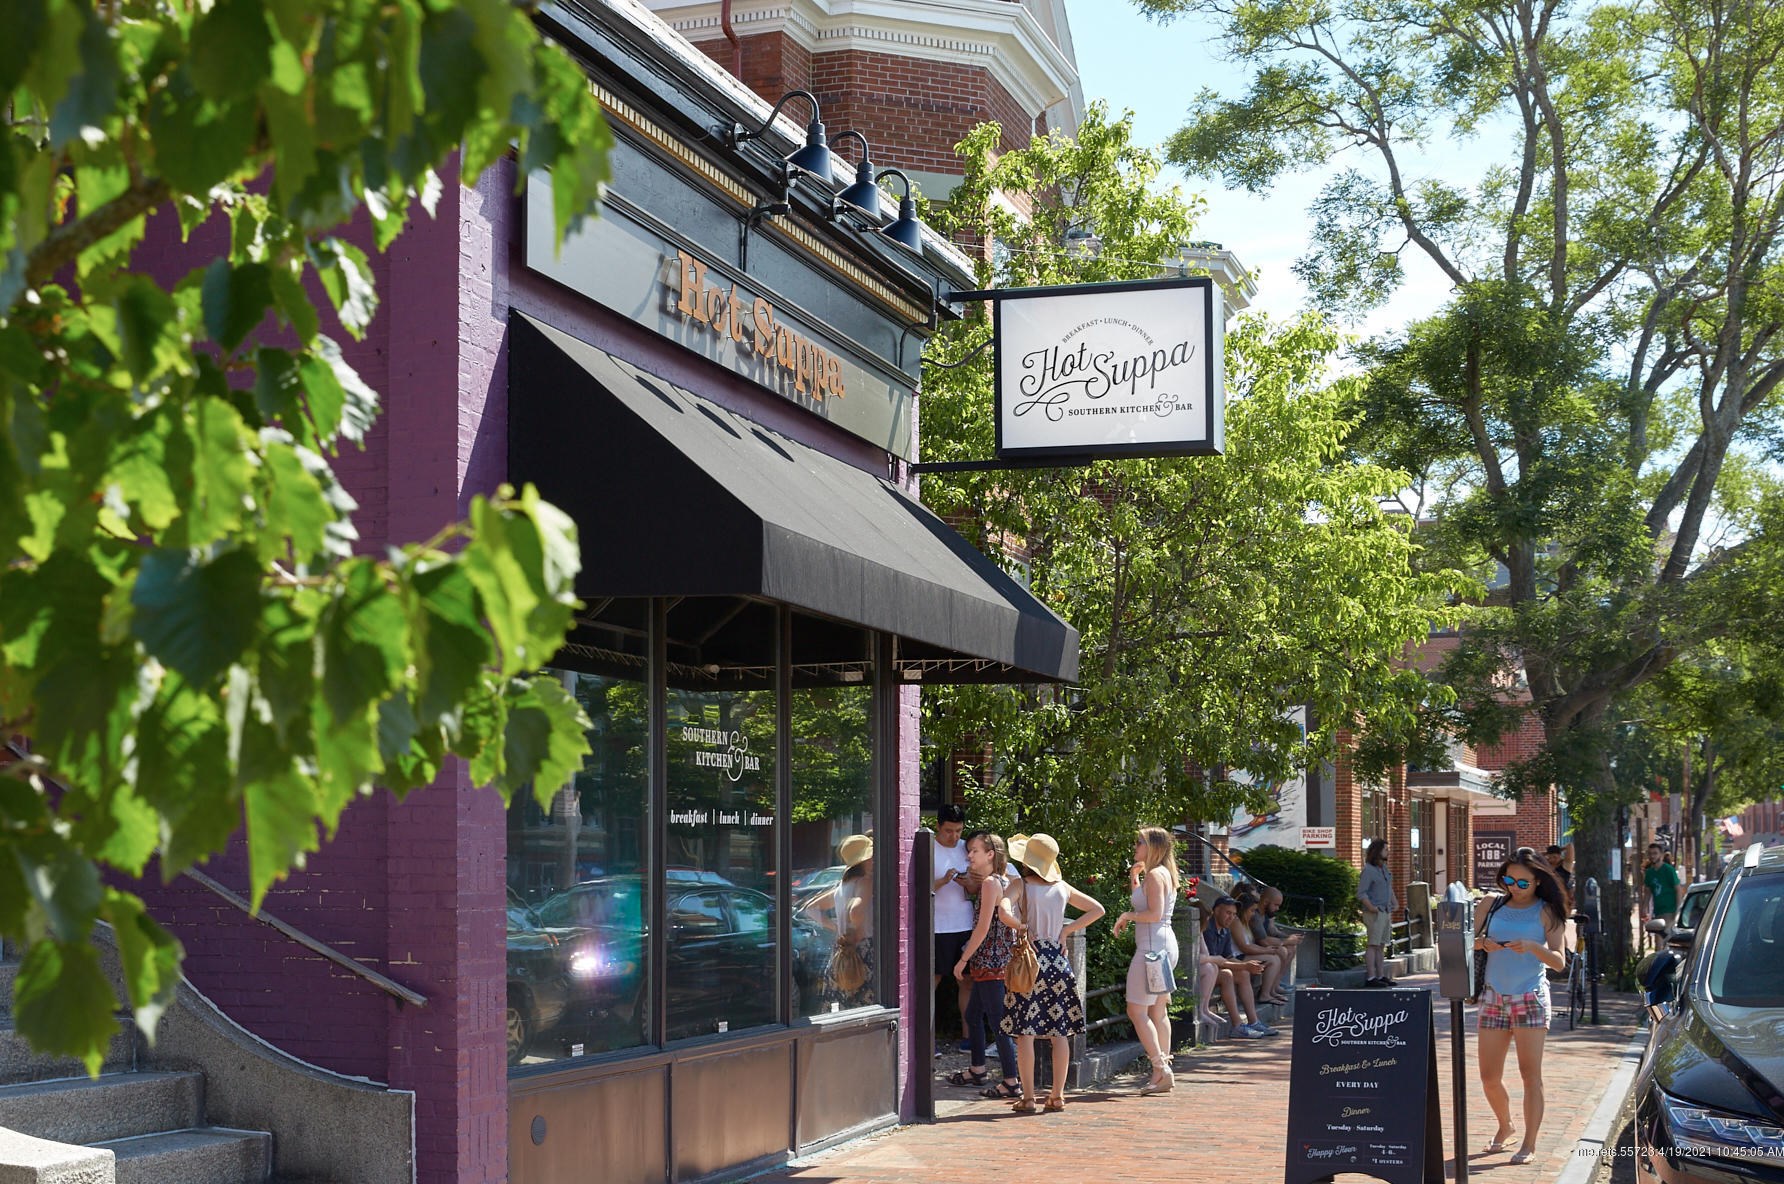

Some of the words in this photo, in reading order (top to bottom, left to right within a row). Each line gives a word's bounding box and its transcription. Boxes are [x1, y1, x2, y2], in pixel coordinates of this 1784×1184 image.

[677, 249, 743, 343] Hot
[753, 296, 846, 401] Suppa
[1062, 318, 1099, 343] BREAKFAST
[1104, 317, 1128, 327] LUNCH
[1132, 324, 1154, 346] DINNER
[1019, 342, 1093, 397] Hot
[1085, 341, 1195, 400] Suppa
[1068, 406, 1117, 417] SOUTHERN
[1120, 404, 1161, 414] KITCHEN
[1154, 393, 1178, 417] &
[1175, 403, 1193, 411] BAR
[682, 727, 728, 745] SOUTHERN
[696, 751, 733, 768] KITCHEN
[727, 731, 748, 781] &
[744, 756, 760, 770] BAR
[670, 809, 708, 828] breakfast
[719, 810, 740, 825] lunch
[750, 812, 774, 826] dinner
[1476, 842, 1506, 850] LOCAL
[1481, 850, 1500, 860] 188
[1316, 1007, 1355, 1034] Hot
[1350, 1010, 1409, 1037] Suppa
[1385, 1035, 1399, 1048] &
[1319, 1063, 1360, 1075] Breakfast
[1361, 1059, 1371, 1069] &
[1373, 1057, 1397, 1067] Lunch
[1341, 1106, 1371, 1118] Dinner
[1326, 1123, 1352, 1131] Tuesday
[1356, 1124, 1384, 1133] Saturday
[1307, 1148, 1333, 1159] Happy
